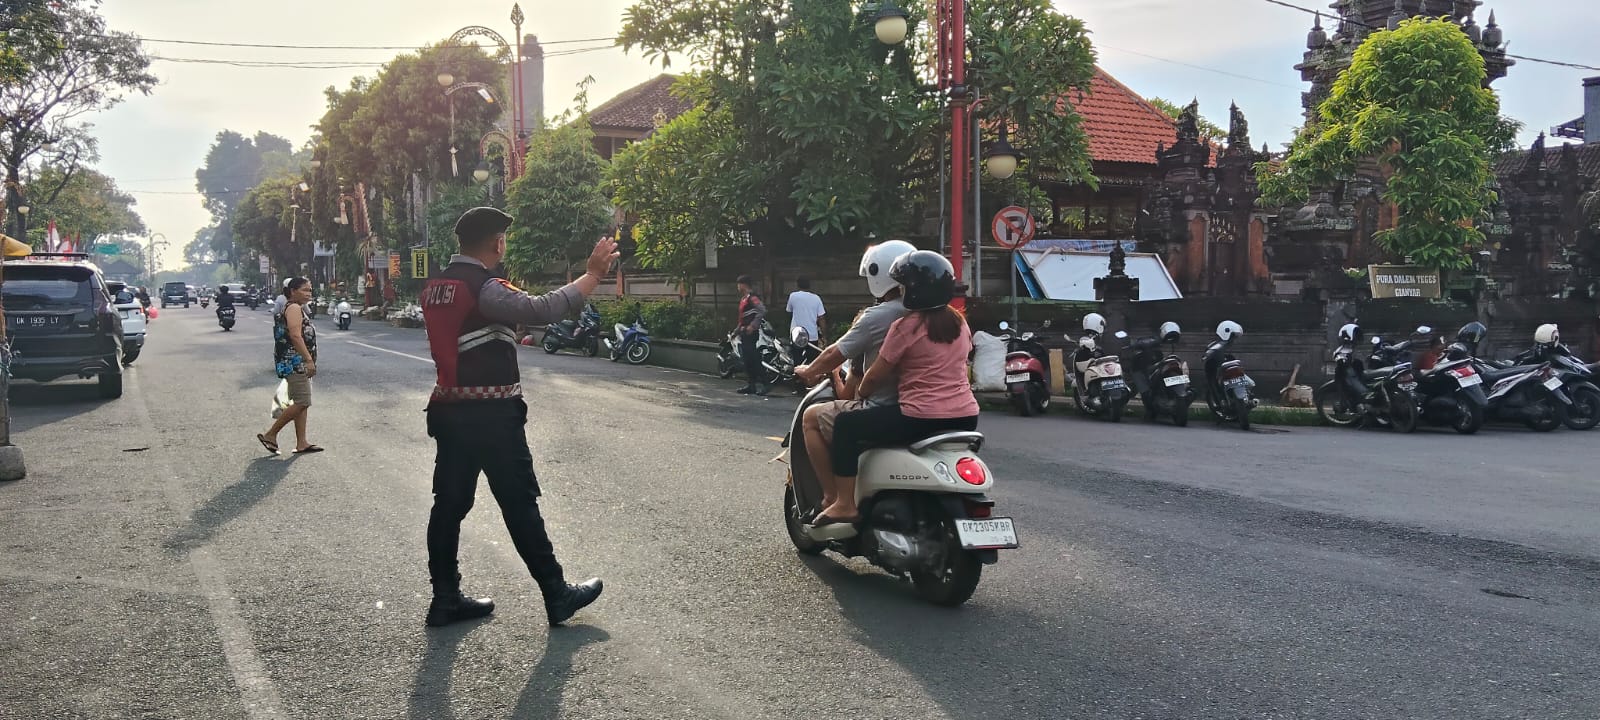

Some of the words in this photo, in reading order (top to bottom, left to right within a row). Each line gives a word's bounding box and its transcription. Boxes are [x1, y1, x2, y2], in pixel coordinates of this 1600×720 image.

[1376, 274, 1393, 284] PURA
[1394, 274, 1416, 284] DALEM
[1416, 275, 1437, 284] TEGES
[1395, 288, 1421, 297] GIANYAR
